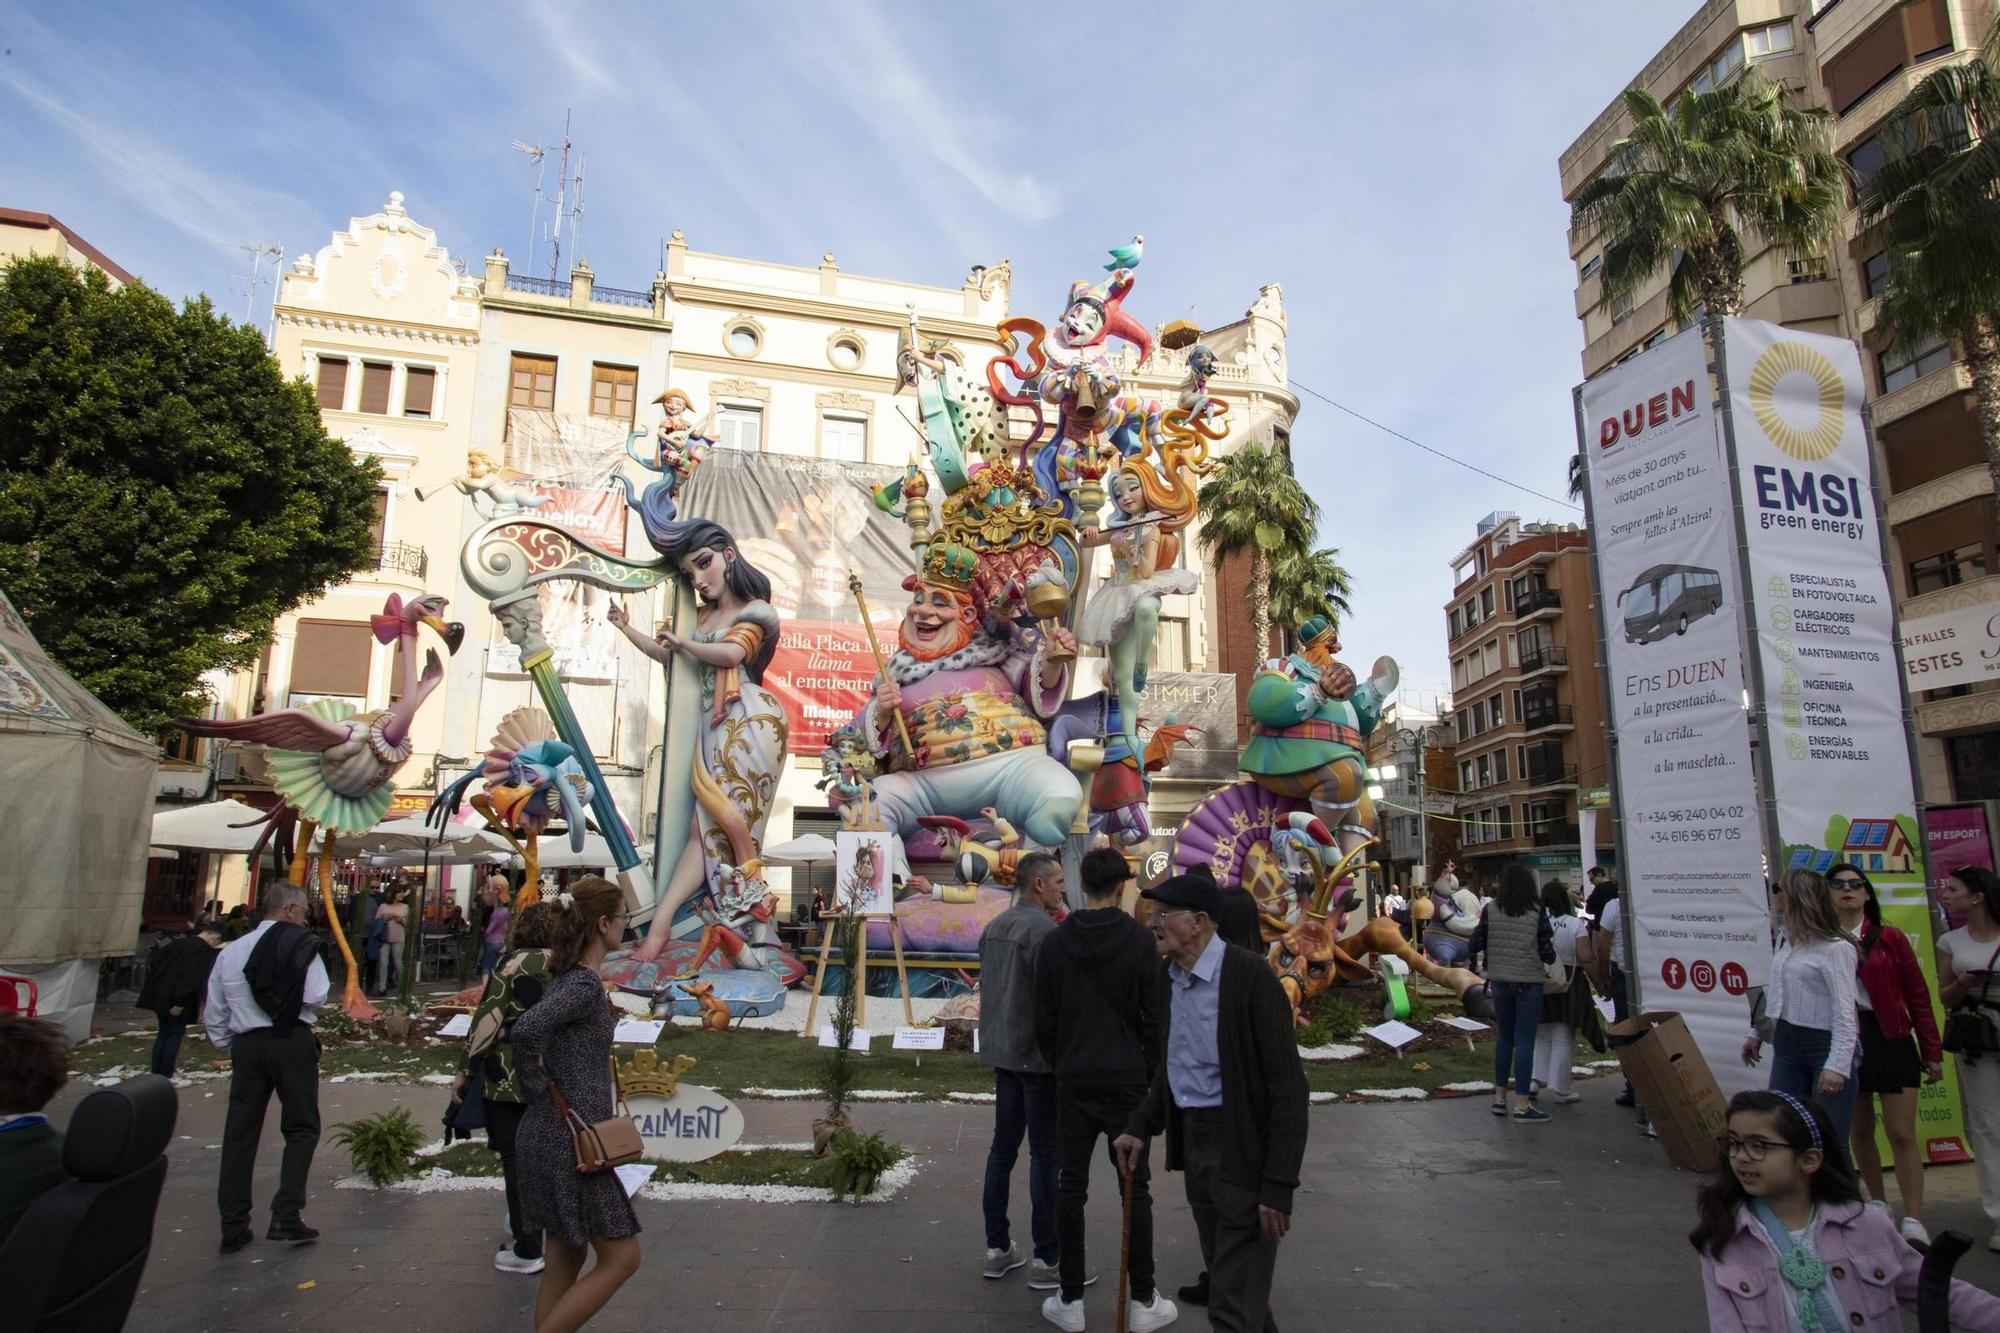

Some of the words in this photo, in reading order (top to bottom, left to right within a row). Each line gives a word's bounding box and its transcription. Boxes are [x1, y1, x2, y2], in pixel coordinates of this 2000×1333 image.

[1600, 379, 1695, 449] DUEN
[1605, 473, 1626, 489] Més
[1628, 467, 1642, 480] de
[1643, 460, 1658, 474] 30
[1659, 449, 1687, 466] anys
[1614, 482, 1656, 505] viatjant
[1657, 470, 1684, 488] amb
[1754, 465, 1862, 519] EMSI
[1610, 518, 1641, 536] Sempre
[1643, 508, 1664, 524] amb
[1666, 505, 1678, 517] les
[1760, 512, 1806, 529] green
[1811, 518, 1864, 540] energy
[1642, 525, 1668, 544] falles
[1790, 573, 1856, 588] ESPECIALISTAS
[1792, 588, 1805, 598] EN
[1807, 590, 1877, 604] FOTOVOLTAICA
[1794, 609, 1855, 623] CARGADORES
[1795, 621, 1850, 635] ELÉCTRICOS
[816, 634, 860, 655] Plaça
[1914, 628, 1956, 646] FALLES
[807, 653, 852, 671] llama
[1798, 647, 1880, 662] MANTENIMIENTOS
[1904, 651, 1963, 675] ESTES
[776, 671, 792, 688] al
[796, 675, 874, 691] encuentr
[1626, 674, 1661, 697] Ens
[1666, 658, 1726, 689] DUEN
[1803, 679, 1854, 691] INGENIERÍA
[1139, 684, 1218, 703] SIMMER
[803, 704, 853, 719] Mahou
[1634, 707, 1641, 717] a
[1643, 702, 1653, 714] la
[1803, 702, 1842, 713] OFICINA
[1644, 735, 1651, 744] a
[1653, 730, 1663, 743] la
[1808, 735, 1854, 748] ENERGÍAS
[1811, 749, 1870, 761] RENOVABLES
[1654, 765, 1661, 774] a
[1664, 759, 1674, 772] la
[1648, 811, 1668, 823] +34
[1668, 810, 1683, 822] 96
[1685, 808, 1707, 821] 240
[1709, 807, 1725, 819] 04
[1728, 806, 1744, 818] 02
[1650, 832, 1669, 843] +34
[1671, 830, 1689, 842] 616
[1691, 829, 1706, 841] 96
[1708, 828, 1721, 840] 67
[1725, 828, 1741, 840] 05
[1943, 828, 1981, 840] ESPORT
[1693, 931, 1723, 940] Valencia
[1919, 1106, 1952, 1122] todos
